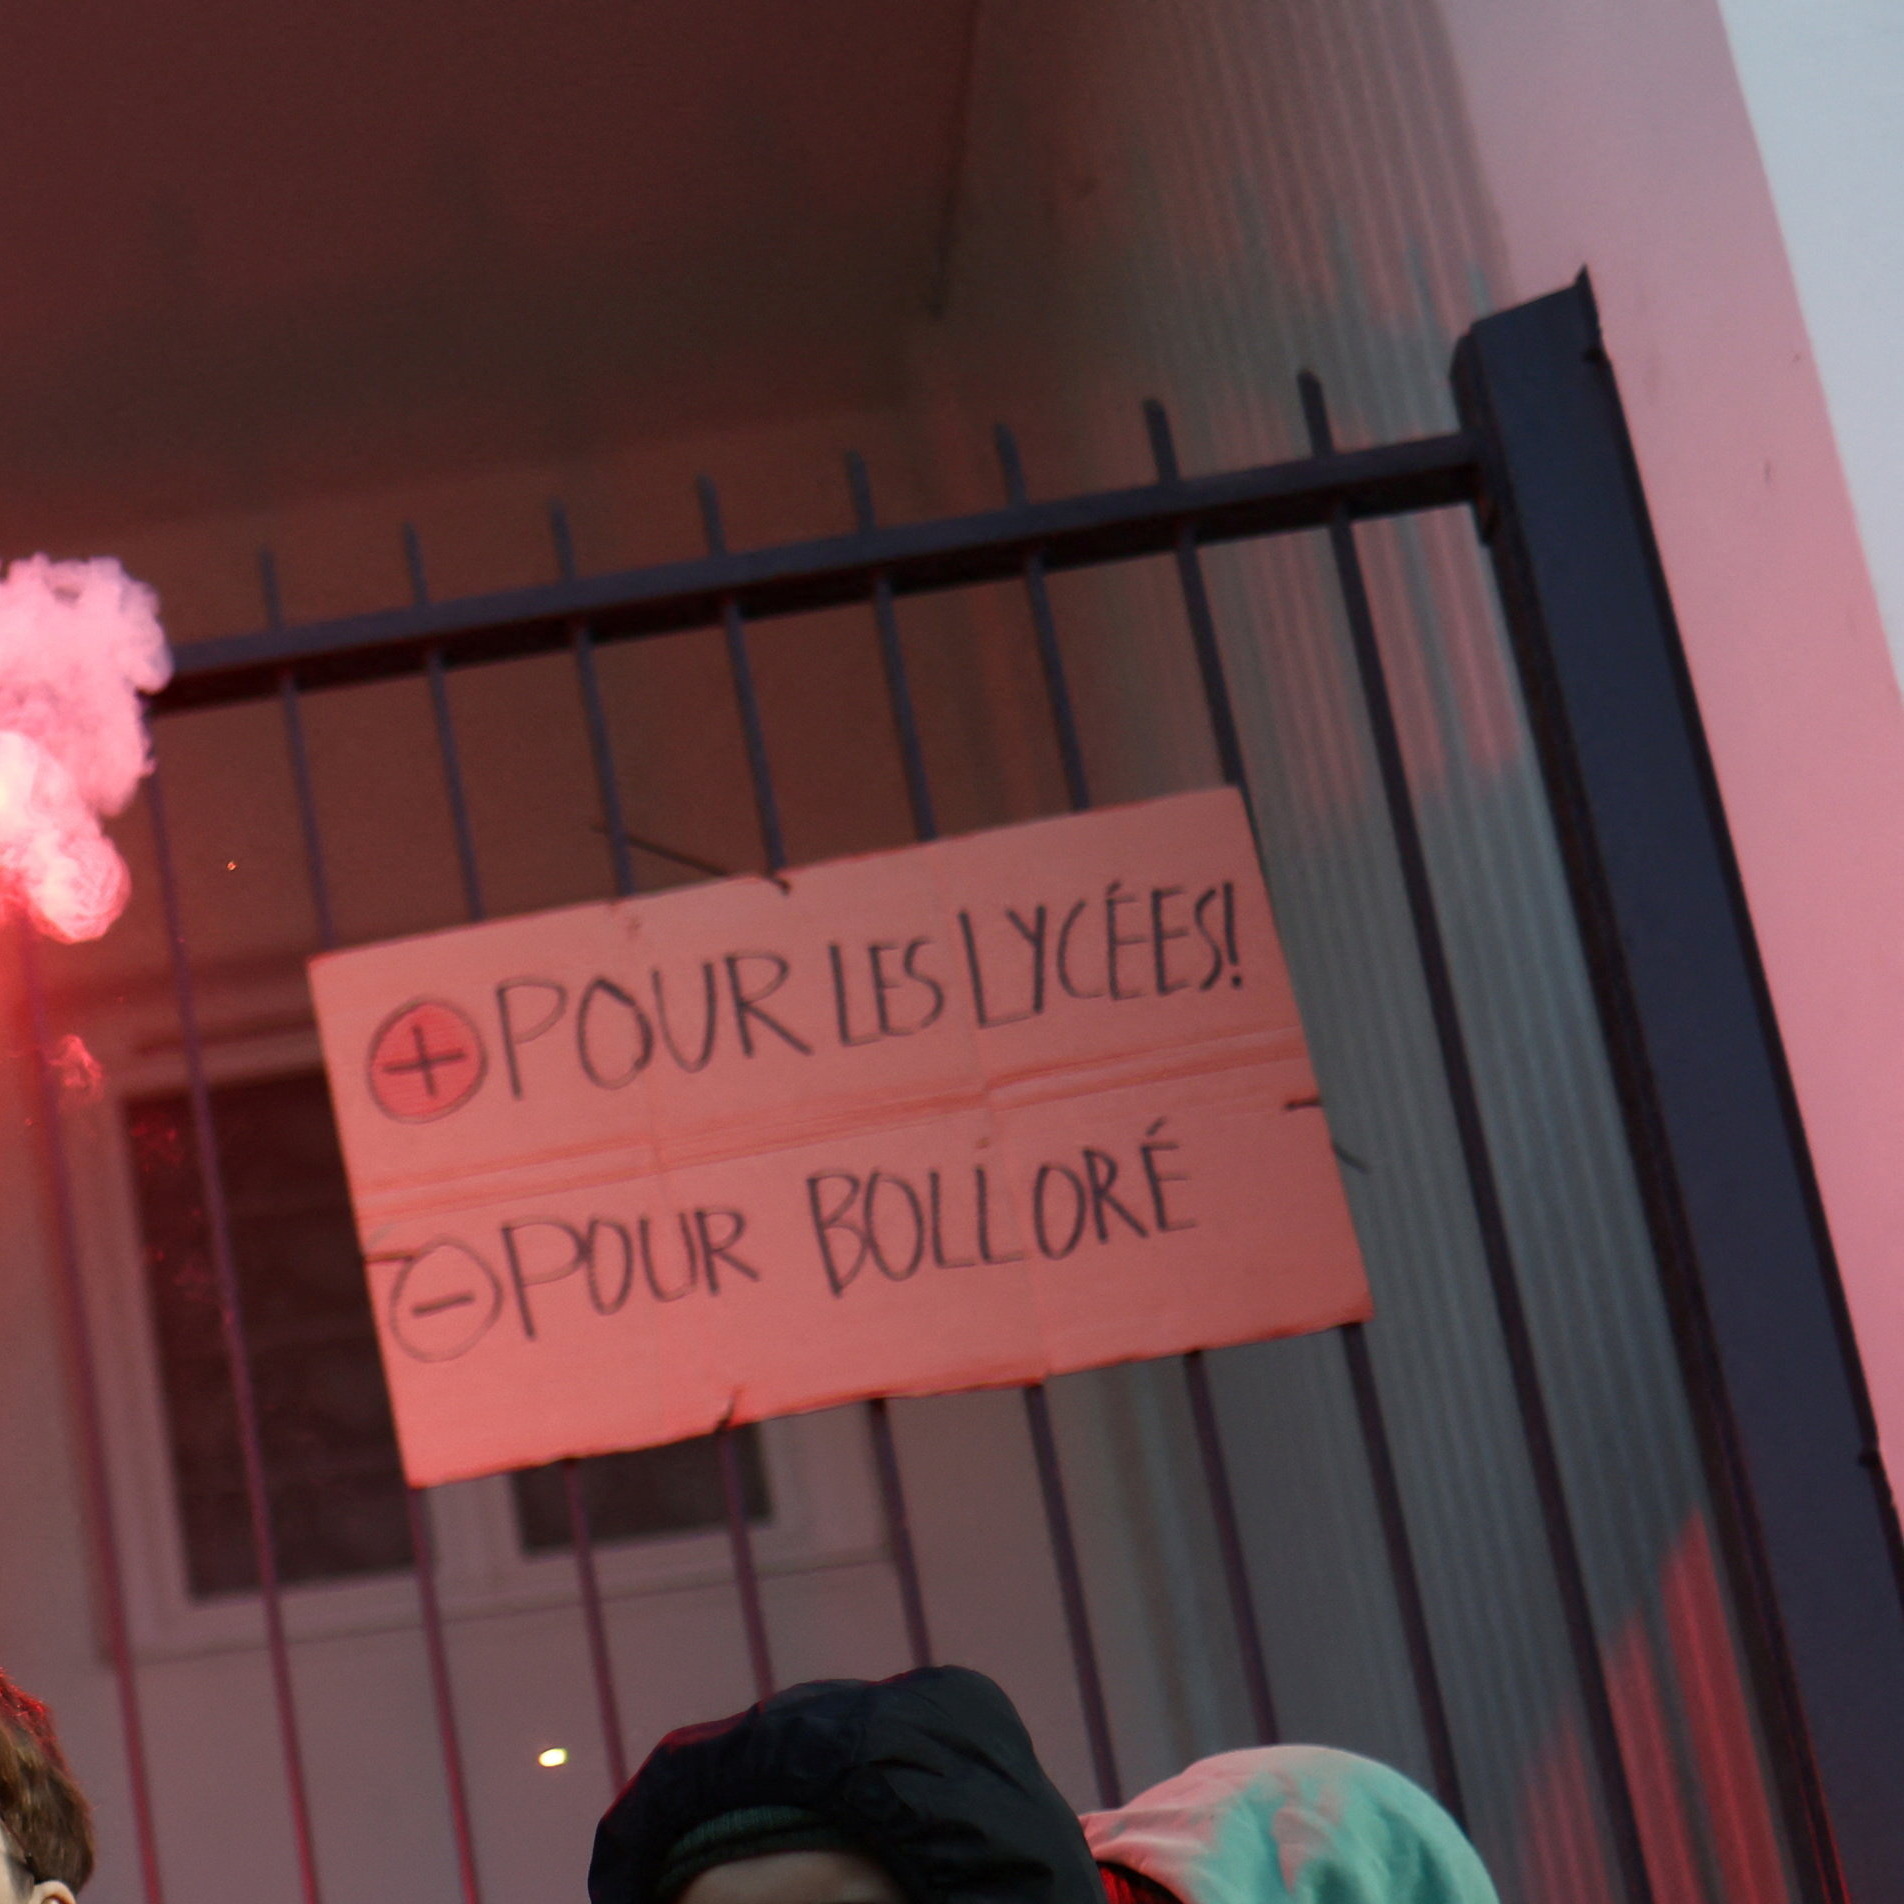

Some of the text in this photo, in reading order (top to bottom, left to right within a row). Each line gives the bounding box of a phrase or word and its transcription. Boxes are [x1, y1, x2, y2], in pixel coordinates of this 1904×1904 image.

[496, 950, 812, 1100] POUR
[828, 935, 944, 1045] LES
[957, 879, 1247, 1030] LYCÉES!
[499, 1206, 760, 1341] POUR
[806, 1117, 1197, 1297] BOLLORÉ
